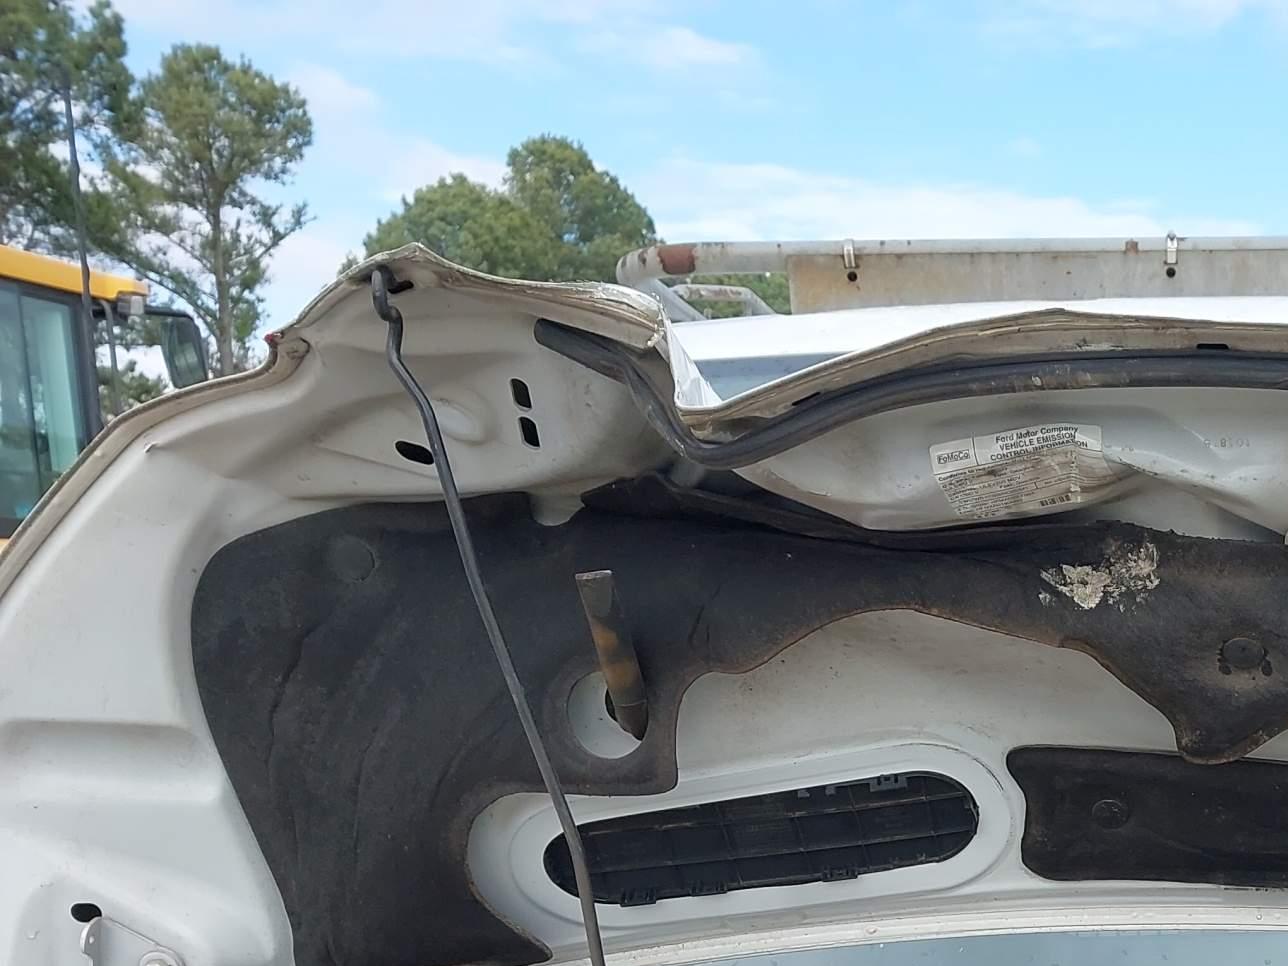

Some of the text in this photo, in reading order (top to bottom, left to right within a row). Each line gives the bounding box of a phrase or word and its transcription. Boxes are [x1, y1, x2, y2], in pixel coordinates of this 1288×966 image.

[996, 426, 1079, 443] Ford Motor Company
[998, 432, 1076, 451] VEHICLE EMISSION
[936, 450, 970, 464] FoMoCo
[990, 448, 1031, 461] CONTROL
